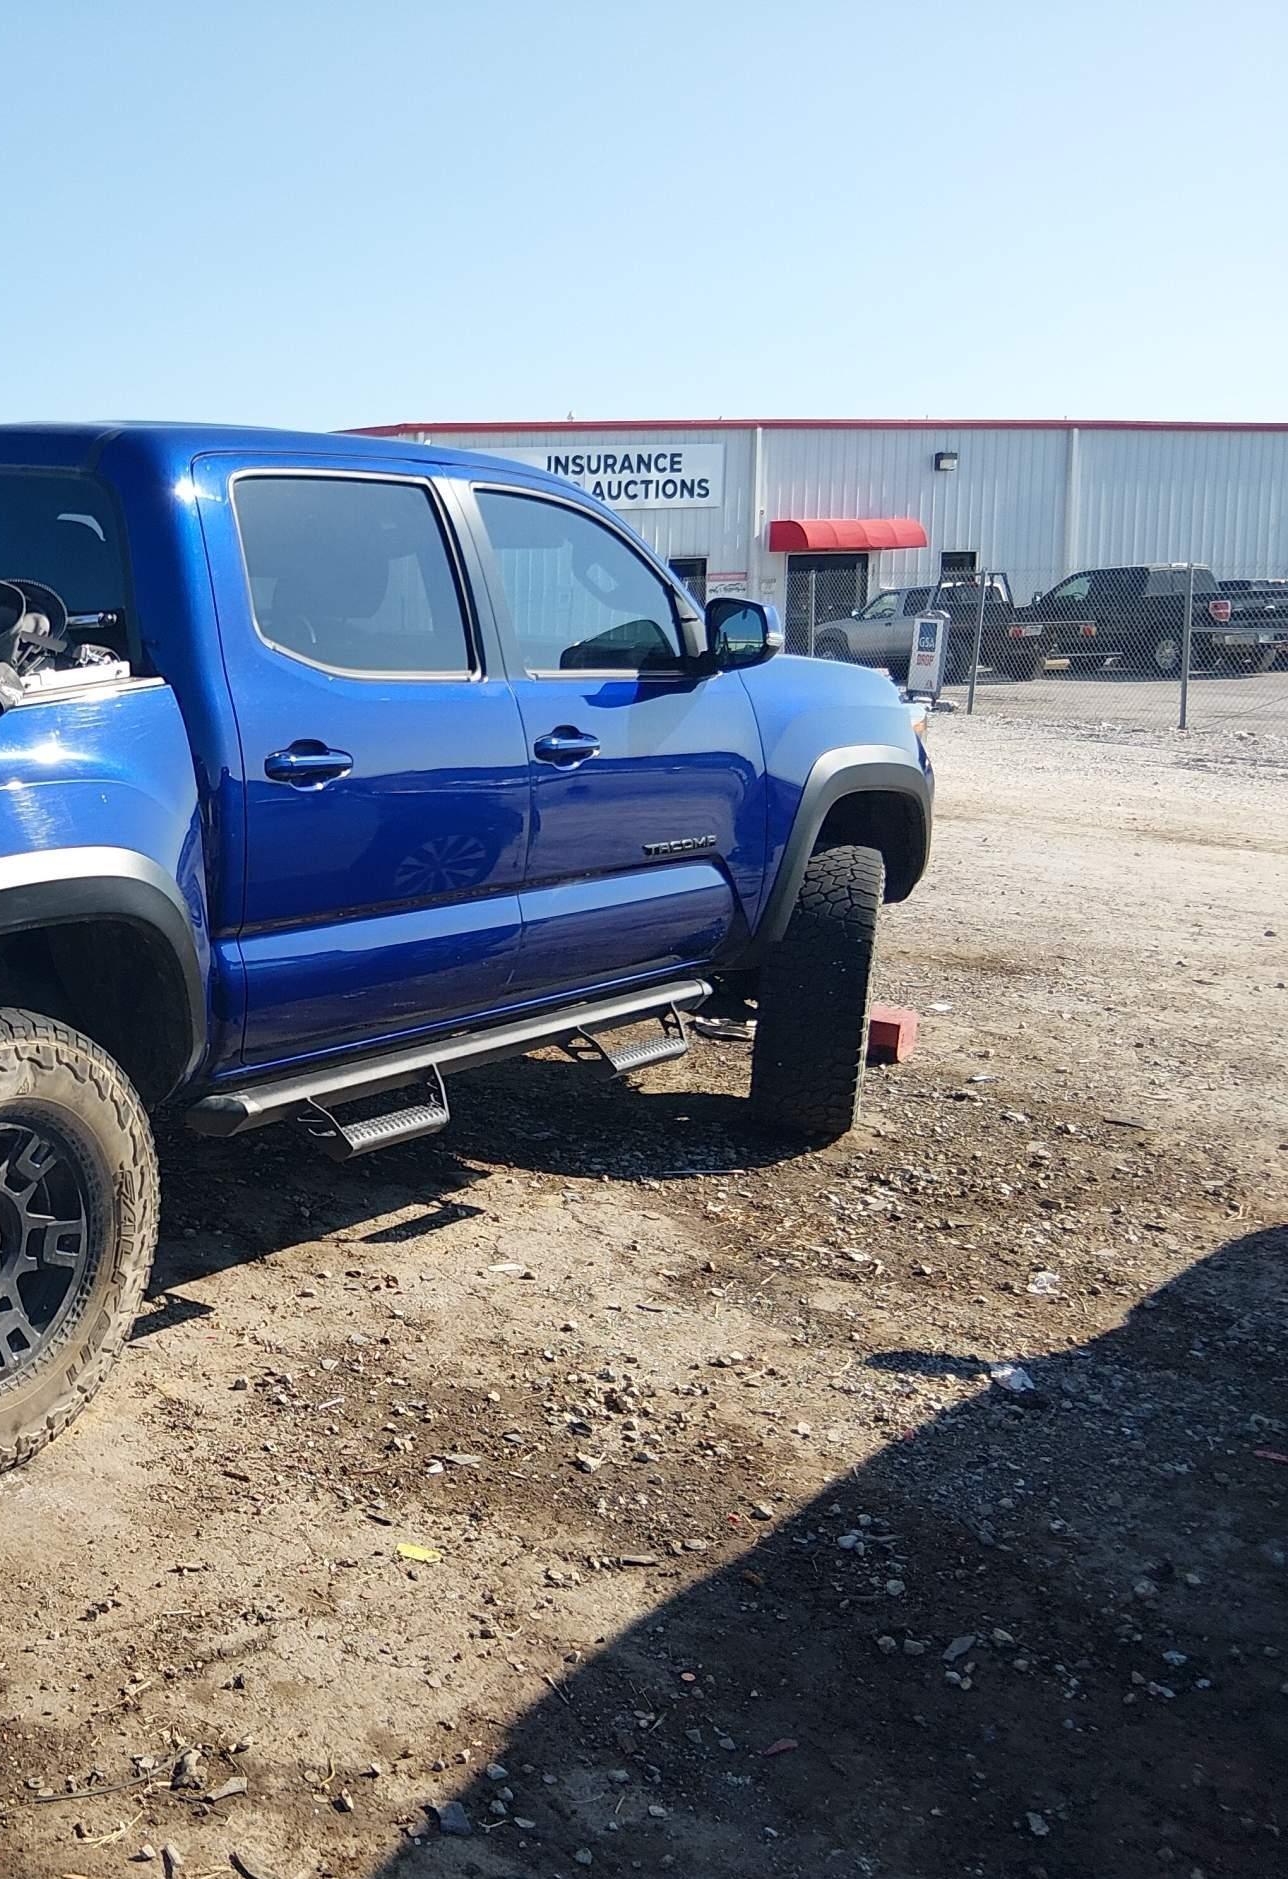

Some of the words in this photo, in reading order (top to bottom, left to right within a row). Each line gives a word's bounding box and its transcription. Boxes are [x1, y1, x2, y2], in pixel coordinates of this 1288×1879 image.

[546, 453, 683, 476] INSURANCE
[592, 478, 710, 501] AUCTIONS
[919, 636, 936, 649] GSA
[642, 834, 717, 855] TACOMA
